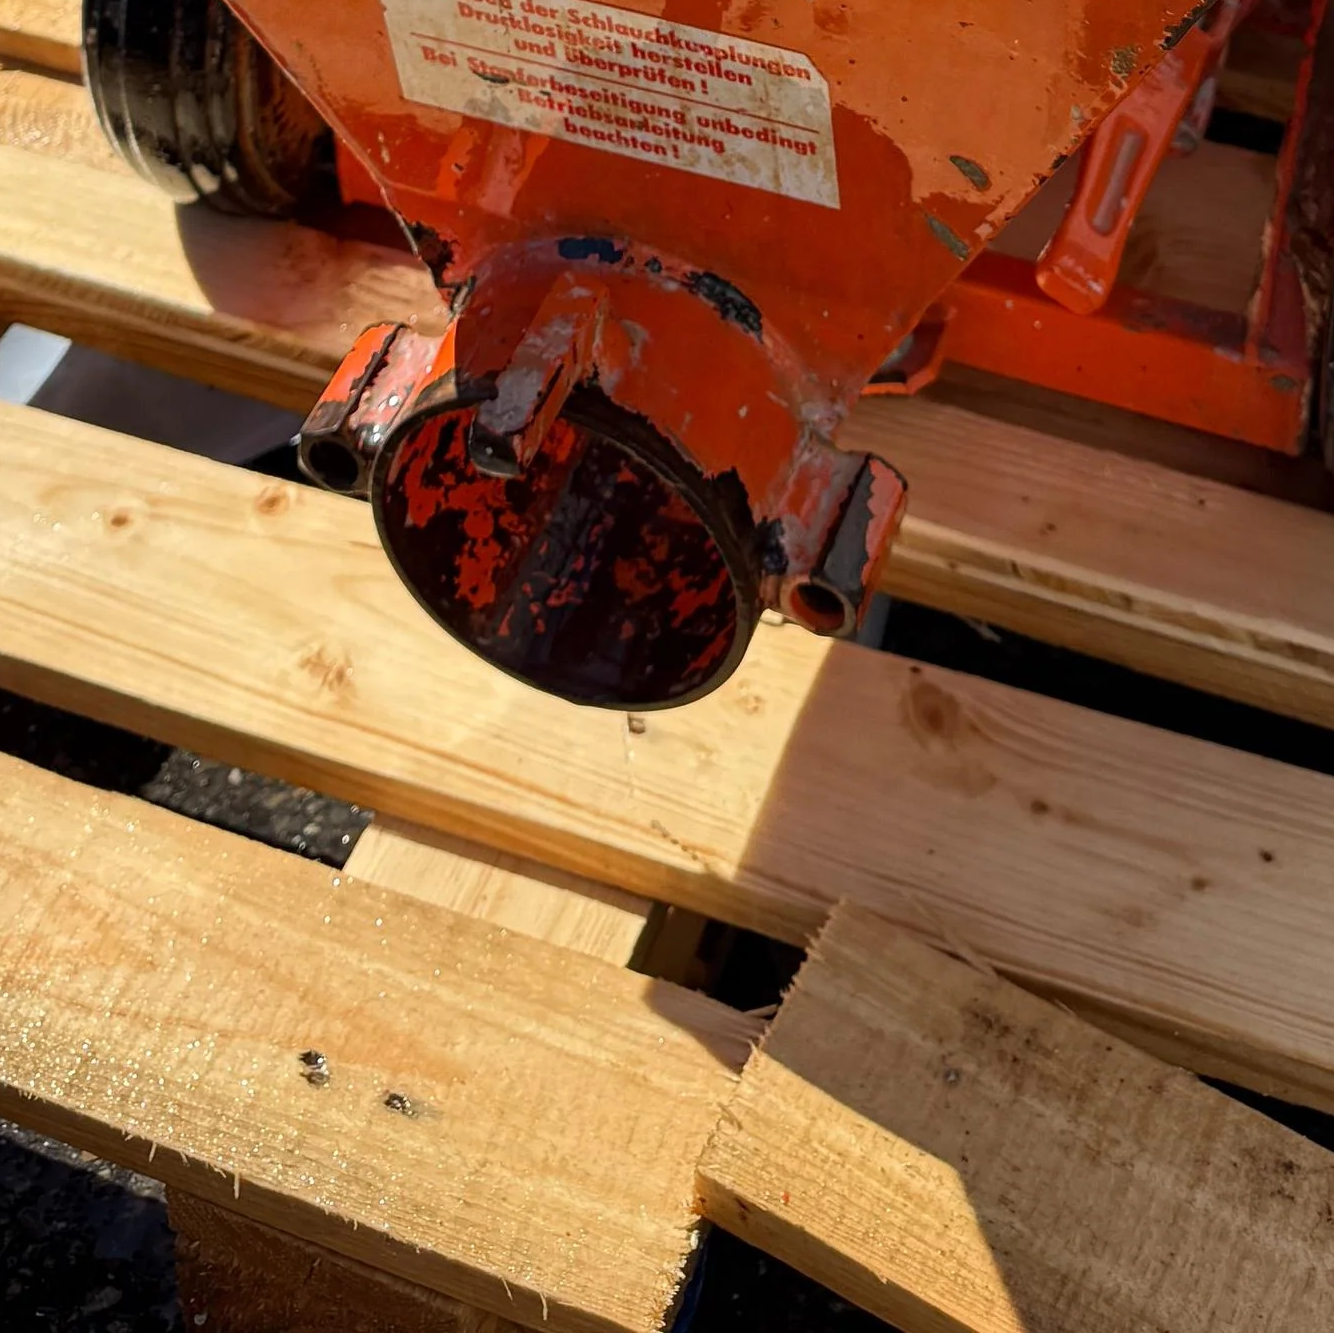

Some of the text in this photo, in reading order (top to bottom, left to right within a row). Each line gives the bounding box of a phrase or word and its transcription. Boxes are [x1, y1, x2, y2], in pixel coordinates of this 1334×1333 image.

[457, 0, 753, 86] Drucklosigkeit herstellen
[513, 37, 557, 59] und
[566, 7, 811, 81] Schlauchkupplungen
[421, 45, 458, 68] Bei
[696, 113, 818, 156] unbedingt
[517, 87, 725, 155] Betriebsanleitung
